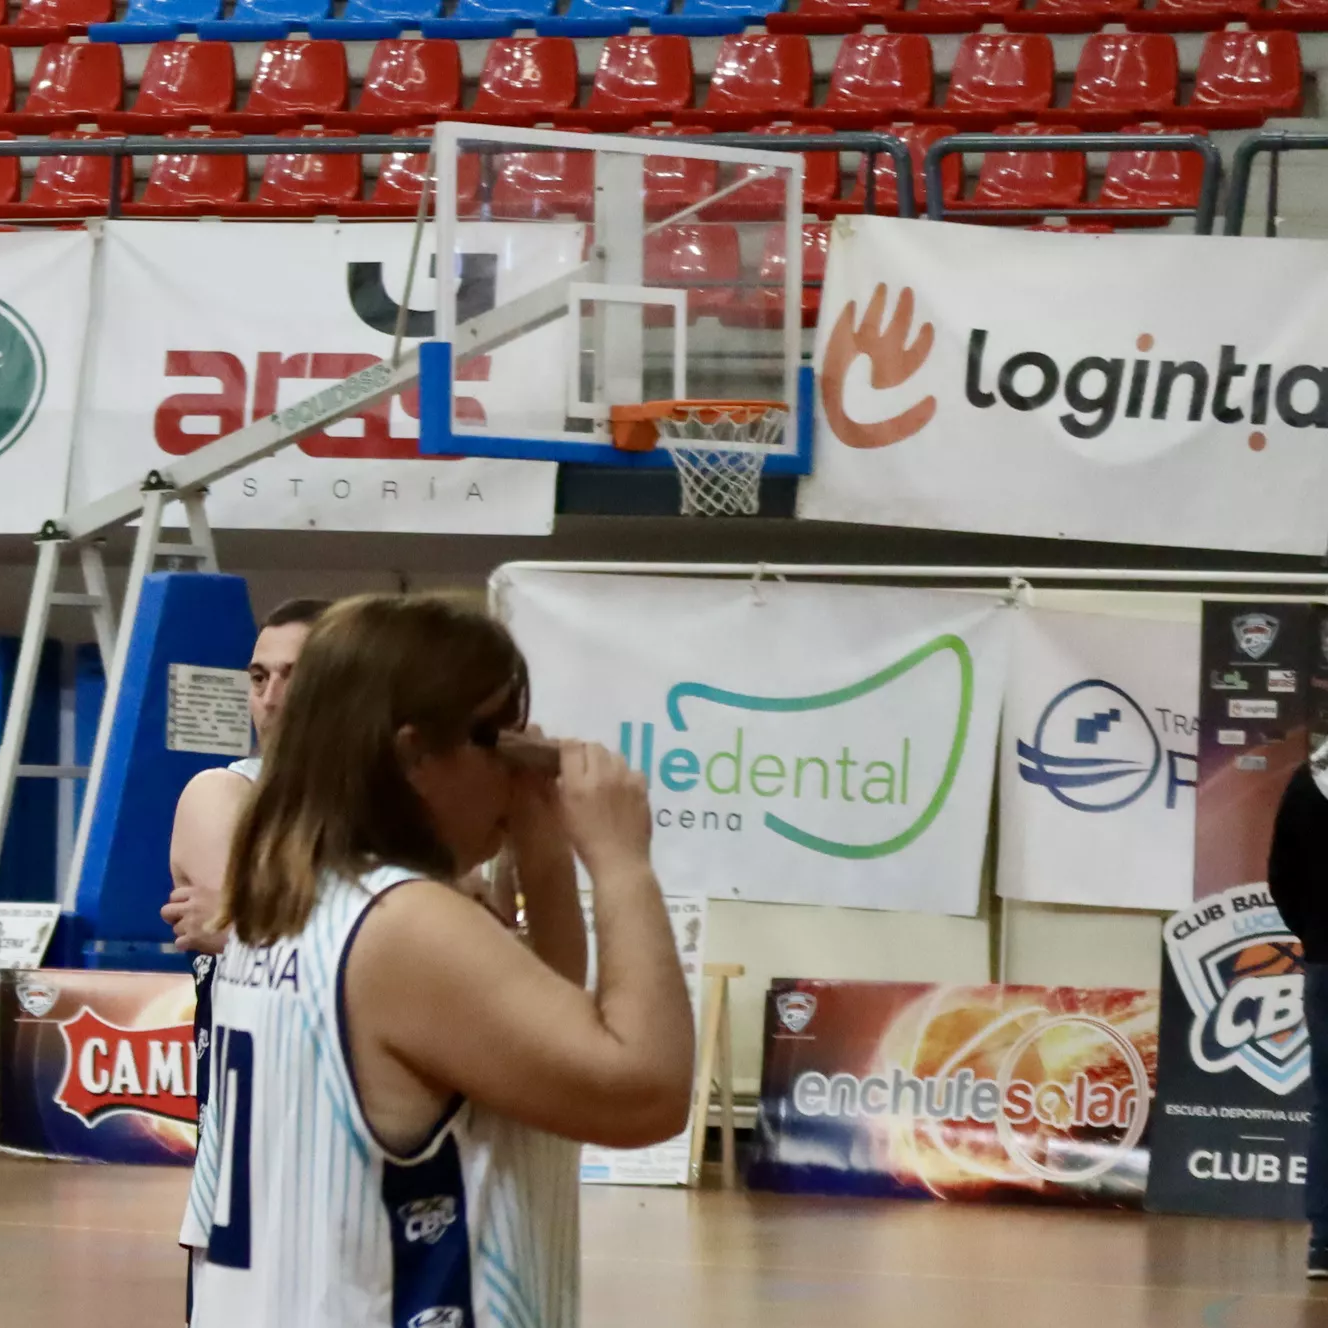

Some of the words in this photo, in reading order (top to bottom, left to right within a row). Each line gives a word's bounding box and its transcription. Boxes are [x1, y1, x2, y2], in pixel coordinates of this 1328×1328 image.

[243, 478, 484, 502] STORÍA
[618, 721, 910, 804] lledental
[656, 806, 742, 832] cena
[1172, 903, 1225, 941] CLUB
[1215, 973, 1306, 1048] CB
[1165, 1104, 1217, 1119] ESCUELA
[1220, 1106, 1287, 1122] DEPORTIVA
[1188, 1151, 1280, 1183] CLUB
